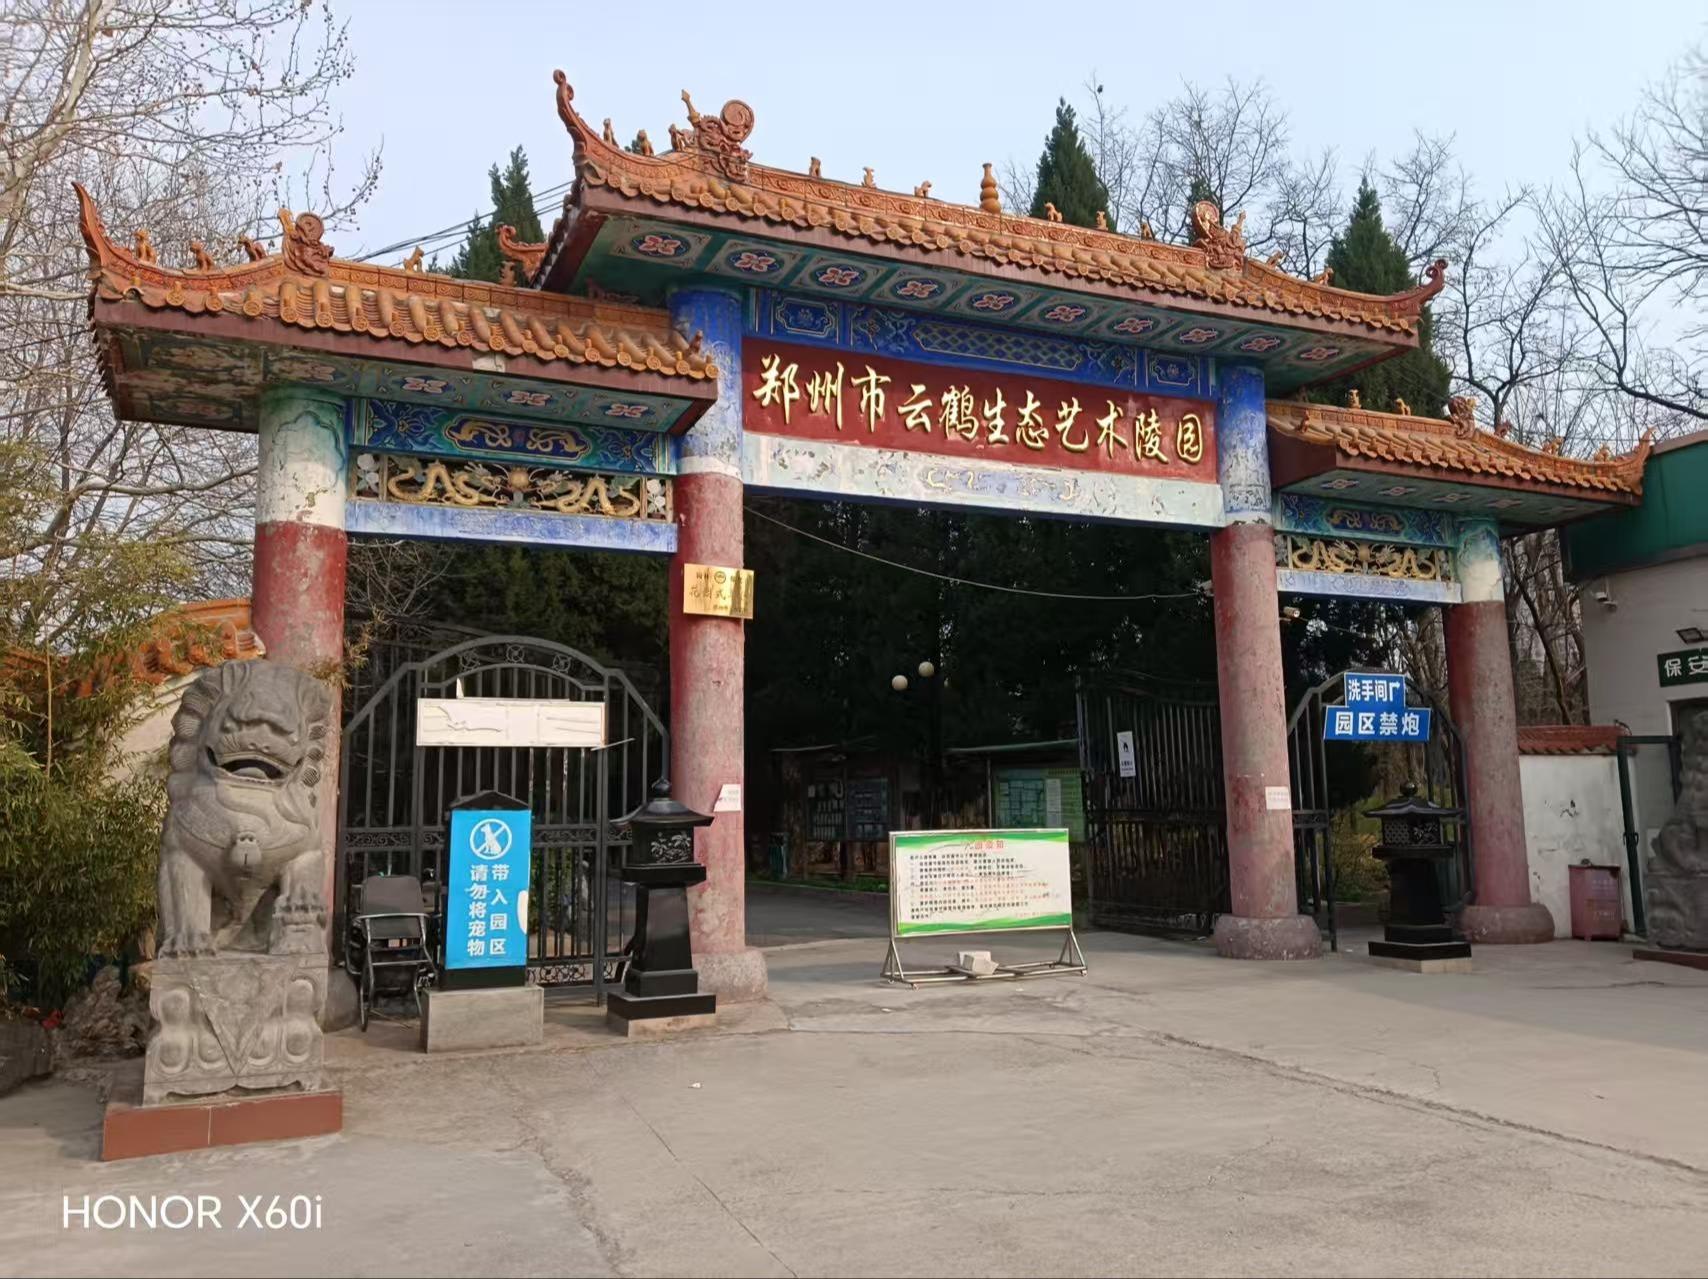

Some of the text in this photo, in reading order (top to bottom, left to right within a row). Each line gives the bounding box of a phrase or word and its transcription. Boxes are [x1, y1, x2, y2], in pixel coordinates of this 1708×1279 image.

[752, 354, 1204, 466] 郑州市云鹤生态艺术陵园
[1335, 711, 1420, 736] 园区禁炮
[466, 864, 490, 957] 请勿将宠物
[489, 864, 510, 955] 带入园区
